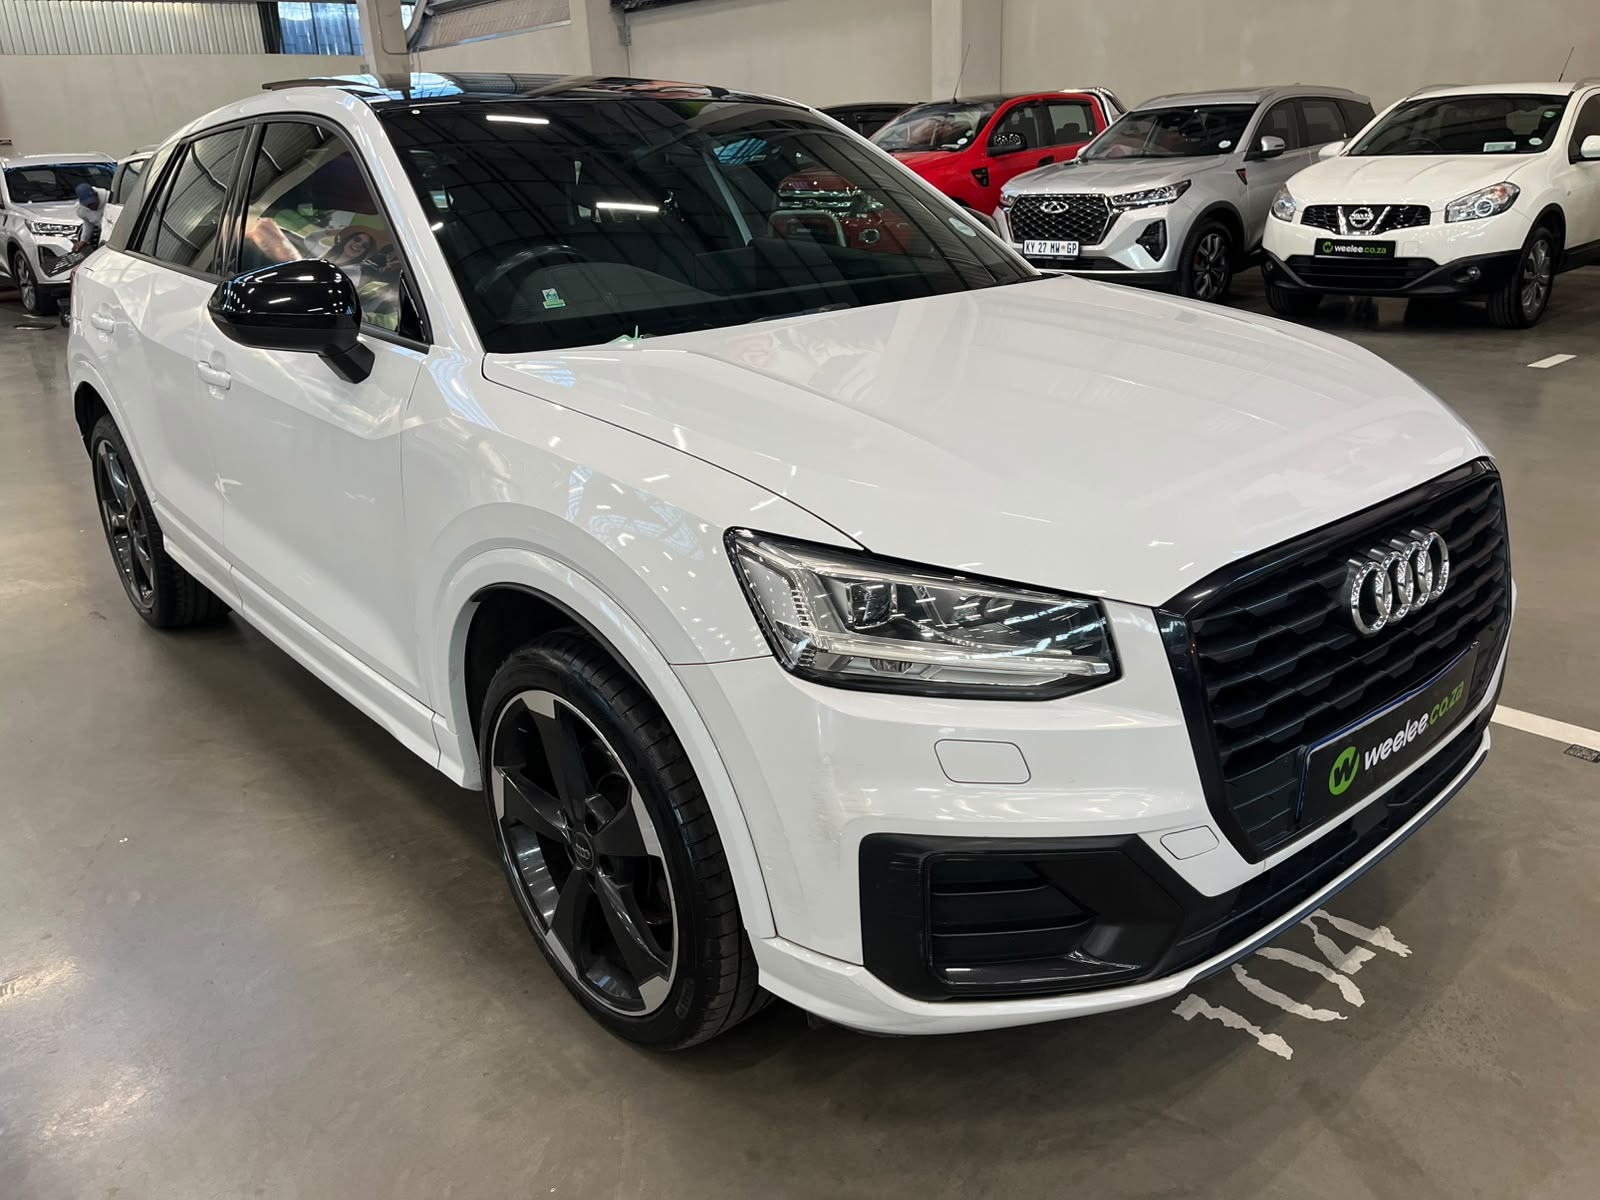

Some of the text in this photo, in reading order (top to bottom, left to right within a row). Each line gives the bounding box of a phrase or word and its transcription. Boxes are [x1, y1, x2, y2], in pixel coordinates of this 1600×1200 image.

[1025, 241, 1077, 254] KY 27 MW GP
[1334, 244, 1387, 254] weelee.co.za
[1364, 680, 1464, 771] weelee.co.za
